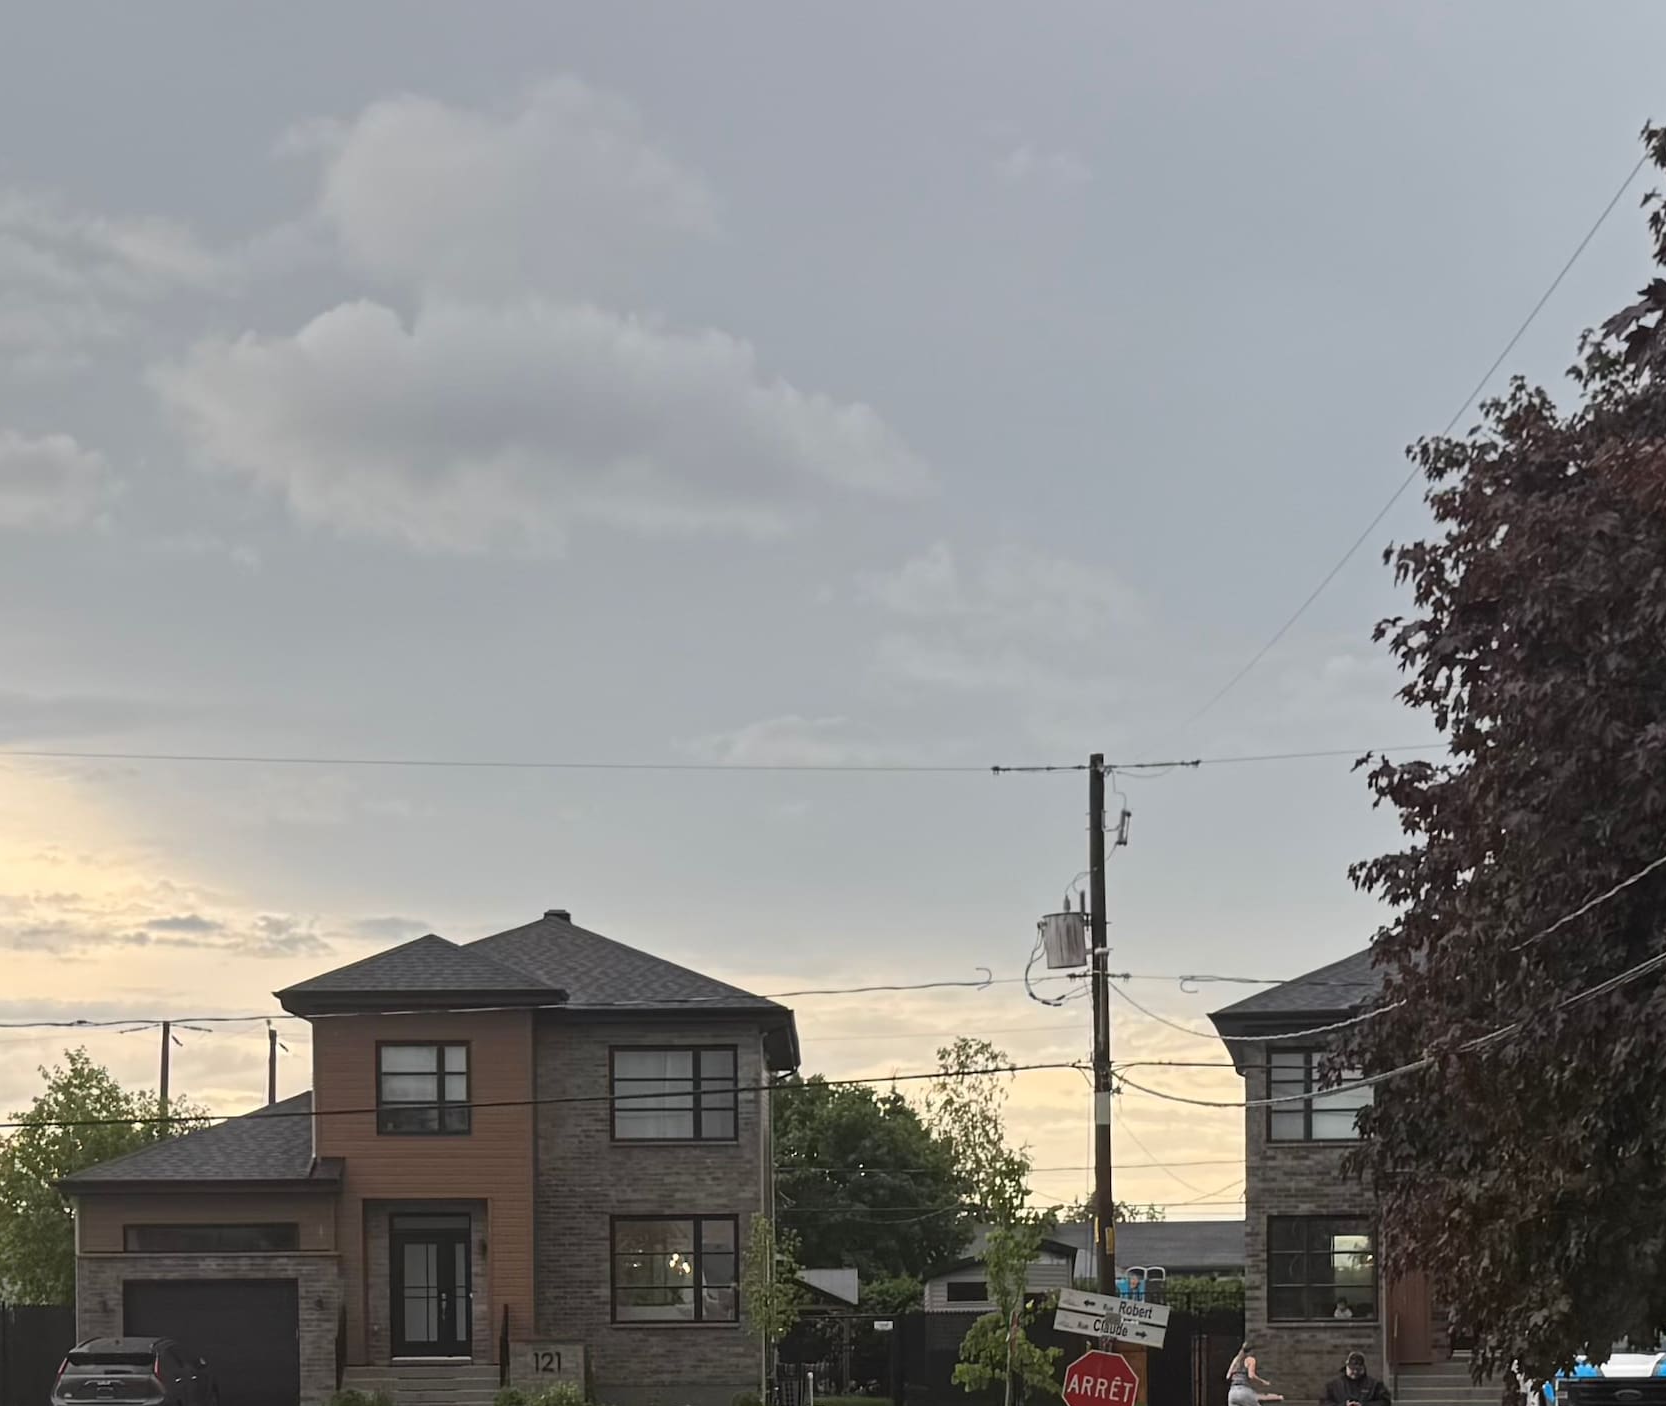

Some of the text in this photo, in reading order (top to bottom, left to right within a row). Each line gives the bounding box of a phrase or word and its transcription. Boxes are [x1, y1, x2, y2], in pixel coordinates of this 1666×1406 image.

[1119, 1301, 1153, 1319] Robert
[1093, 1319, 1128, 1337] Claude
[533, 1351, 561, 1374] 121
[1067, 1374, 1134, 1403] ARRÊT
